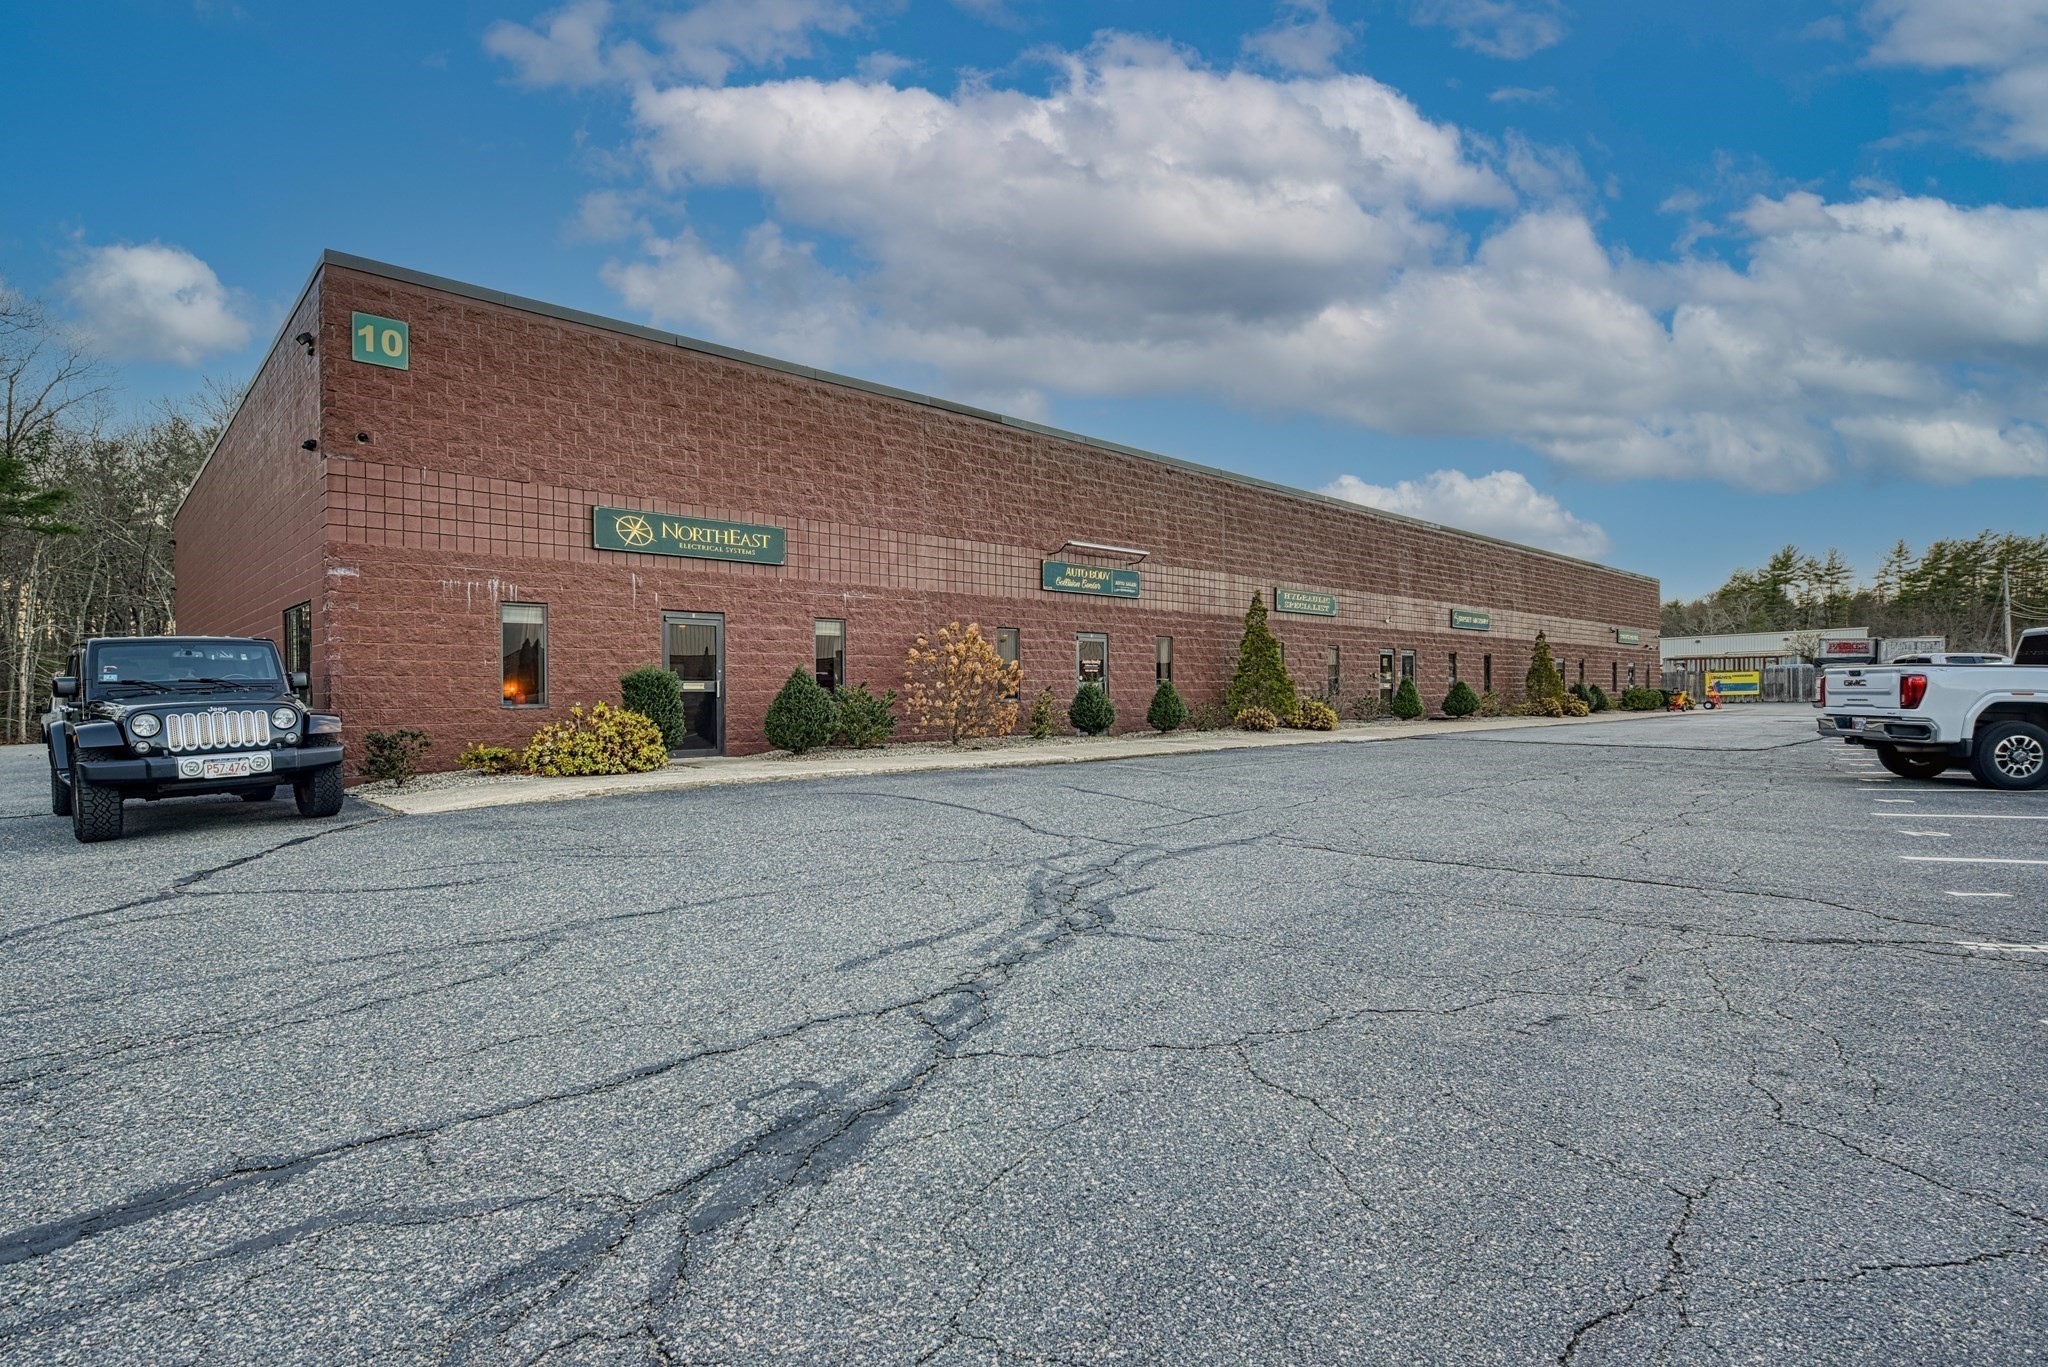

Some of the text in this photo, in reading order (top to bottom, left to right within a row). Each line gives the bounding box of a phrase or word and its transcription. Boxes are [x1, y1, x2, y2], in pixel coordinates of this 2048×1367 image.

[357, 324, 403, 358] 10
[679, 542, 756, 556] ELECTRICAL SYSTEMS
[1065, 567, 1111, 581] AUTO BODY
[1055, 576, 1101, 590] Collision Center
[1284, 592, 1331, 604] HYDRAULIC
[1284, 600, 1330, 612] SPECIALIST
[1843, 679, 1867, 687] GMC
